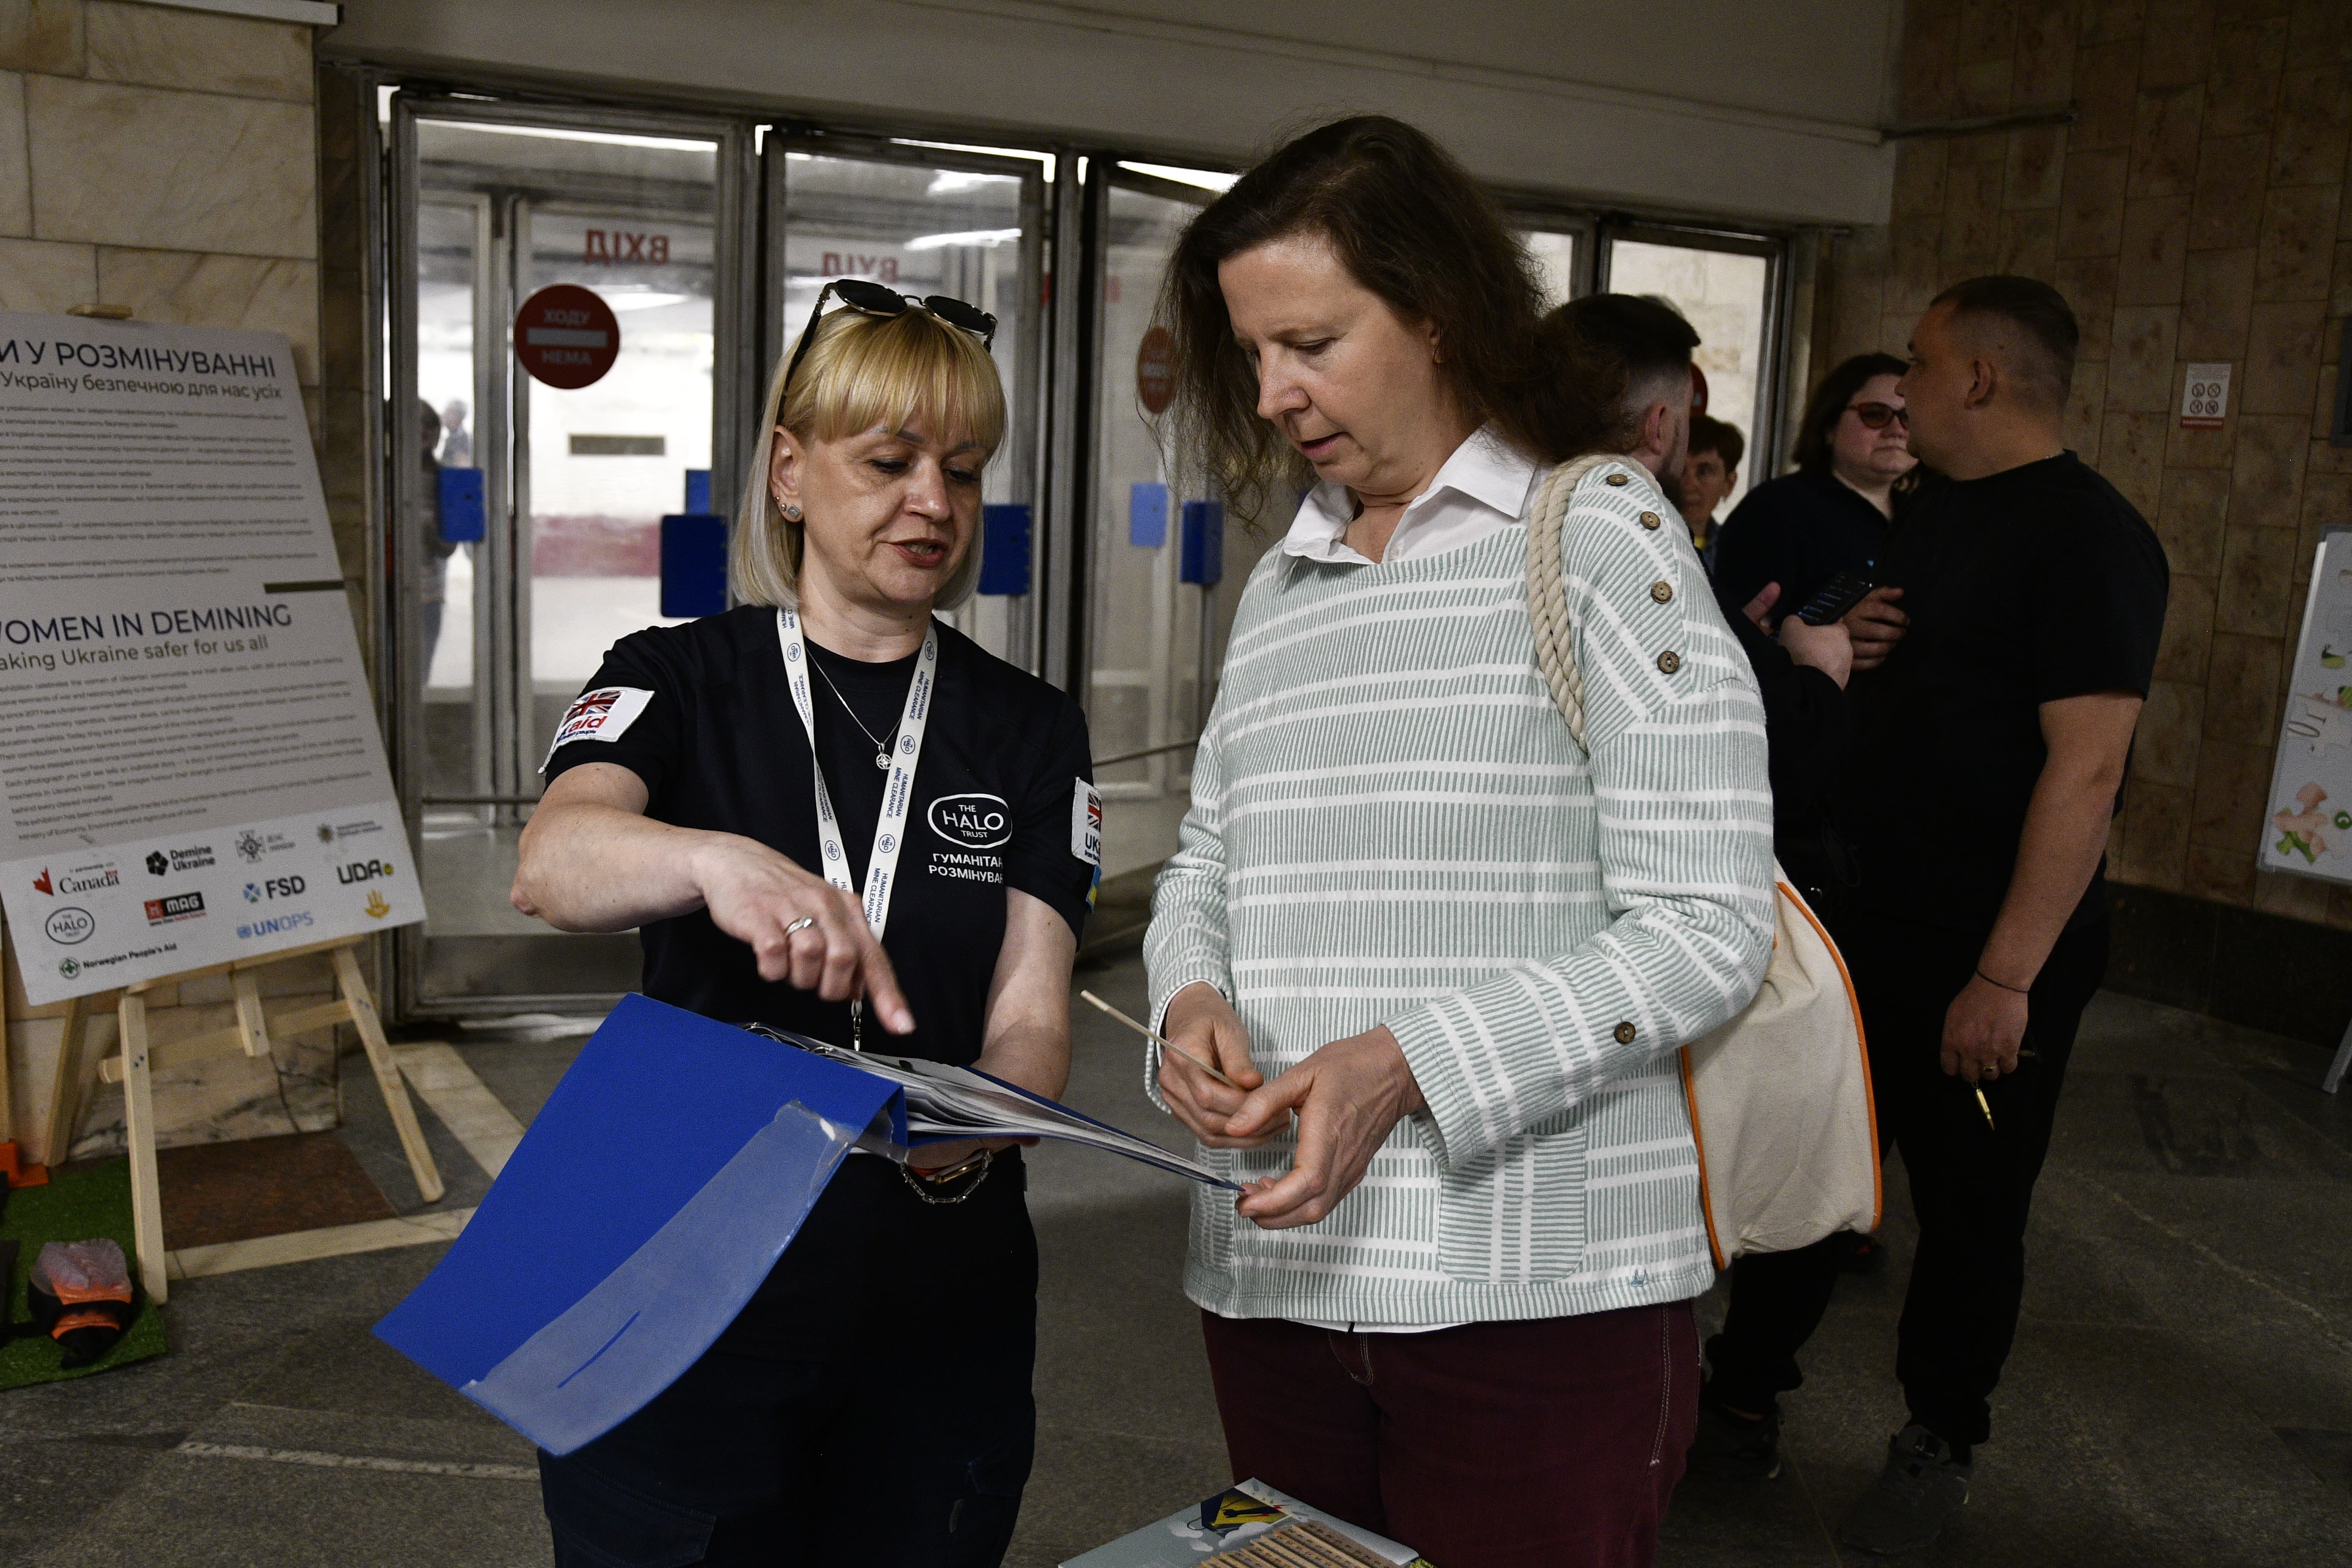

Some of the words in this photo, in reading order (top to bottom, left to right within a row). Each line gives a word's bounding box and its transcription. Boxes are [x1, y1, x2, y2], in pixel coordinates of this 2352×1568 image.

[544, 308, 590, 327] ХОДУ
[25, 340, 45, 364] У
[55, 342, 275, 377] РОЗМІНУВАННІ
[542, 348, 591, 365] НЕМА
[0, 371, 78, 393] Україну
[83, 373, 184, 395] безпечною
[188, 383, 218, 396] для
[221, 385, 249, 398] нас
[253, 384, 281, 401] усіх
[0, 615, 103, 644] OMEN
[112, 612, 143, 637] IN
[151, 604, 291, 634] DEMINING
[62, 645, 139, 666] Ukraine
[144, 640, 188, 659] safer
[194, 638, 218, 654] for
[224, 639, 245, 653] us
[249, 634, 269, 651] all
[909, 685, 921, 720] CLEARANCE
[917, 678, 930, 720] HUMANITARIAN
[568, 716, 607, 733] aid
[894, 767, 902, 782] MINE
[886, 783, 898, 818] CLEARANCE
[895, 773, 909, 817] HUMANITARIAN
[942, 810, 1004, 830] HALO
[171, 846, 212, 859] Demine
[172, 857, 215, 871] Ukraine
[59, 871, 120, 893] Canada
[337, 860, 382, 884] UDA
[872, 868, 881, 884] MINE
[265, 876, 305, 899] FSD
[874, 873, 888, 923] HUMANITARIAN
[53, 917, 87, 933] HALO
[254, 912, 314, 936] UNOPS
[84, 954, 127, 968] Norwegian
[129, 946, 162, 960] People's
